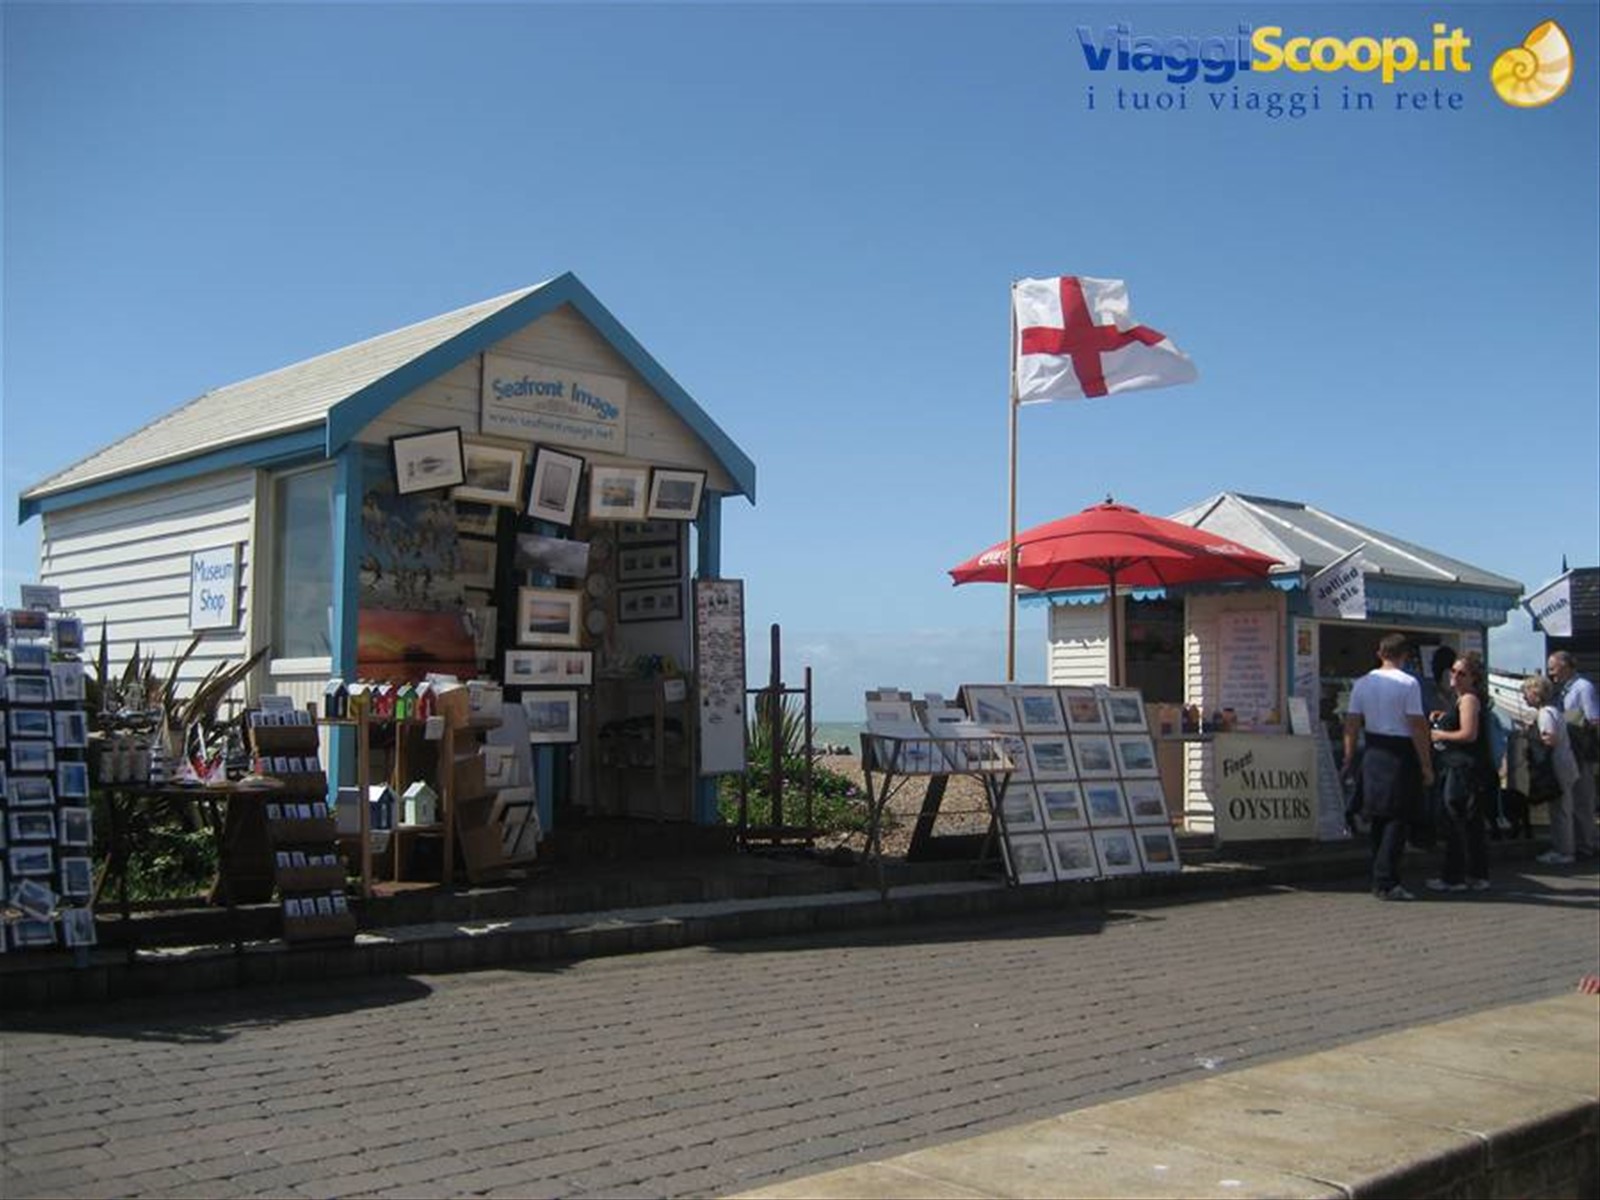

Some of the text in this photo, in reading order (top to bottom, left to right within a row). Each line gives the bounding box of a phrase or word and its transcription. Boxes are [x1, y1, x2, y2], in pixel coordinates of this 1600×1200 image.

[492, 375, 620, 419] Seafront Image
[194, 560, 233, 582] Museum
[1317, 567, 1358, 599] Jellied
[200, 588, 226, 619] Shop
[1241, 770, 1309, 790] MALDON
[1229, 797, 1311, 821] OYSTERS
